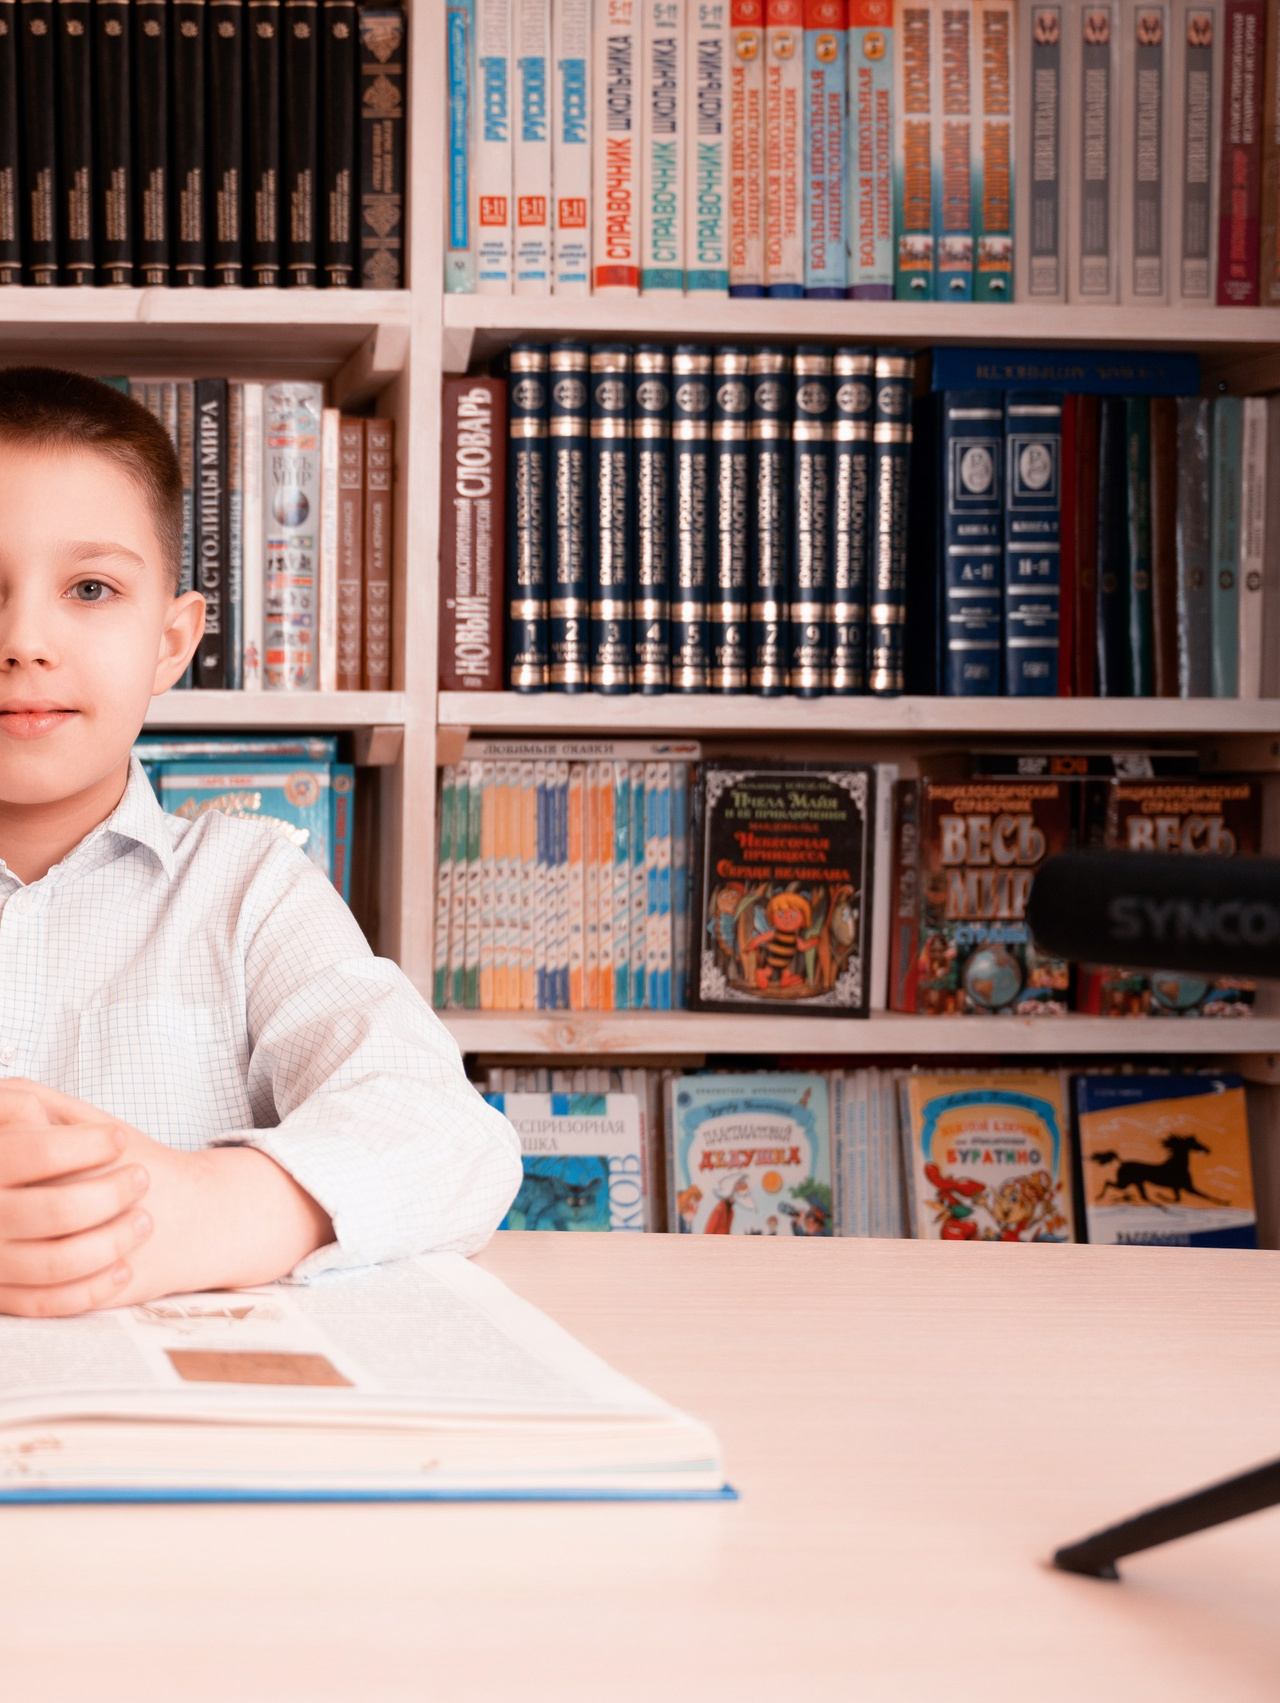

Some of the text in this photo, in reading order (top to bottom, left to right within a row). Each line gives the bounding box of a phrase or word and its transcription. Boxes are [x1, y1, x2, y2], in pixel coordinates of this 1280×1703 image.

[479, 56, 507, 142] РУССКИЙ
[517, 56, 545, 142] РУССКИЙ
[558, 58, 586, 144] РУССКИЙ
[606, 35, 631, 260] СПРАВОЧНИК ШКОЛЬНИКА
[652, 38, 677, 262] СПРАВОЧНИК ШКОЛЬНИКА
[697, 40, 722, 262] СПРАВОЧНИК ШКОЛЬНИКА
[731, 66, 746, 268] БОЛЬШАЯ ШКОЛЬНАЯ
[748, 88, 761, 240] ЭНЦИКЛОПЕДИЯ
[767, 66, 783, 267] БОЛЬШАЯ ШКОЛЬНАЯ
[784, 87, 798, 238] ЭНЦИКЛОПЕДИЯ
[810, 69, 826, 271] БОЛЬШАЯ ШКОЛЬНАЯ
[828, 92, 844, 243] ЭНЦИКЛОПЕДИЯ
[858, 66, 876, 268] БОЛЬШАЯ ШКОЛЬНАЯ
[876, 90, 891, 240] ЭНЦИКЛОПЕДИЯ
[455, 387, 492, 498] СЛОВАРЬ
[199, 400, 222, 635] ВСЕ СТОЛИЦЫ МИРА
[447, 598, 490, 676] НОВЫЙ
[526, 624, 536, 641] 1
[565, 620, 579, 641] 2
[605, 622, 619, 643] 3
[646, 622, 660, 641] 4
[686, 624, 700, 645] 5
[724, 625, 740, 645] 6
[765, 623, 778, 644] 7
[805, 625, 820, 646] 9
[837, 625, 861, 645] 10
[483, 742, 615, 755] ЛЮБИМЫЕ СКАЗКИ
[927, 784, 1060, 801] ЭНЦИКЛОПЕДИЧЕСКИЙ
[952, 799, 1033, 815] СПРАВОЧНИК
[1140, 799, 1223, 815] СПРАВОЧНИК
[937, 813, 1048, 867] ВЕСЬ
[1124, 813, 1238, 858] ВЕСЬ
[944, 867, 1035, 921] МИР
[509, 1119, 625, 1135] ЕСПРИЗОРНАЯ
[521, 1136, 559, 1151] ШКА
[697, 1145, 803, 1172] ДЕДУШКА
[945, 1148, 1042, 1166] БУРАТИНО
